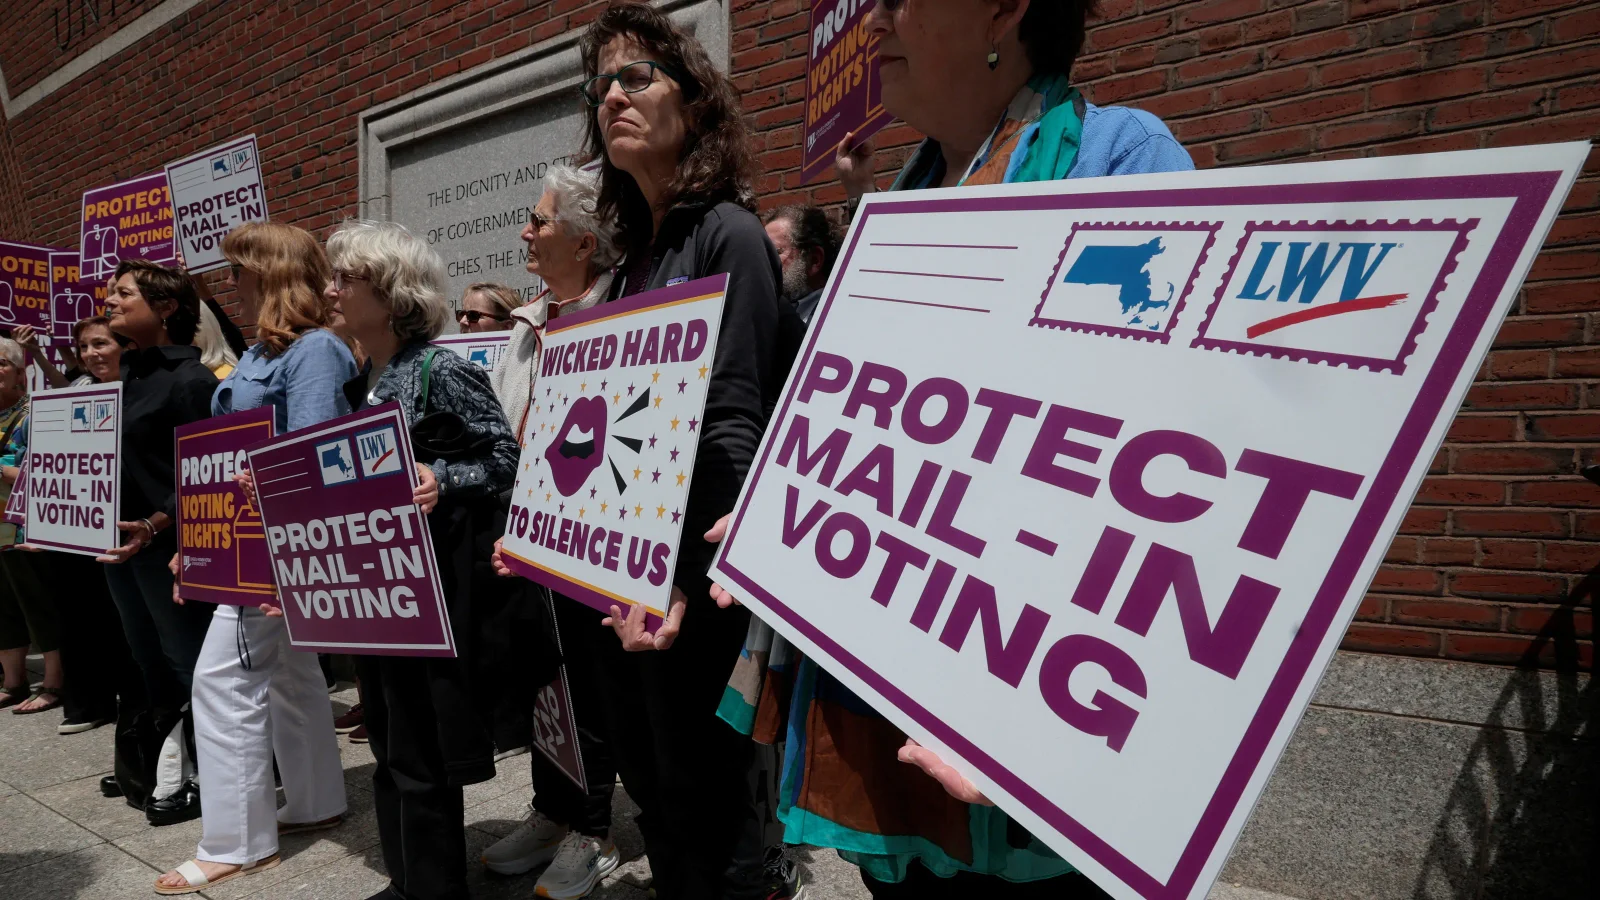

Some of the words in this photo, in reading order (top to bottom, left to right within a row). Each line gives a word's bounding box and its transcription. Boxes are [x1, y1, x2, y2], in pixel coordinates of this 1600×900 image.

[808, 53, 864, 127] RIGHTS
[178, 183, 259, 222] PROTECT
[427, 188, 451, 208] THE
[456, 172, 511, 201] DIGNITY
[514, 162, 548, 186] AND
[84, 185, 171, 222] PROTECT
[119, 206, 174, 230] MAIL-IN
[119, 225, 174, 249] VOTING
[190, 229, 231, 254] VOT
[427, 227, 444, 245] OF
[447, 205, 536, 240] GOVERNMEN
[447, 258, 483, 278] CHES,
[486, 251, 513, 270] THE
[1236, 241, 1398, 304] LWV
[14, 277, 49, 294] MAI
[14, 294, 50, 312] VOT
[541, 333, 618, 378] WICKED
[619, 318, 709, 368] HARD
[360, 433, 386, 460] LWV
[797, 351, 1366, 561] PROTECT
[31, 453, 115, 476] PROTECT
[181, 449, 247, 487] PROTEC
[36, 502, 105, 529] VOTING
[181, 492, 235, 520] VOTING
[182, 522, 232, 550] RIGHTS
[267, 504, 416, 554] PROTECT
[508, 504, 530, 539] TO
[528, 510, 624, 573] SILENCE
[626, 535, 671, 587] US
[292, 585, 420, 619] VOTING
[781, 483, 1148, 754] VOTING
